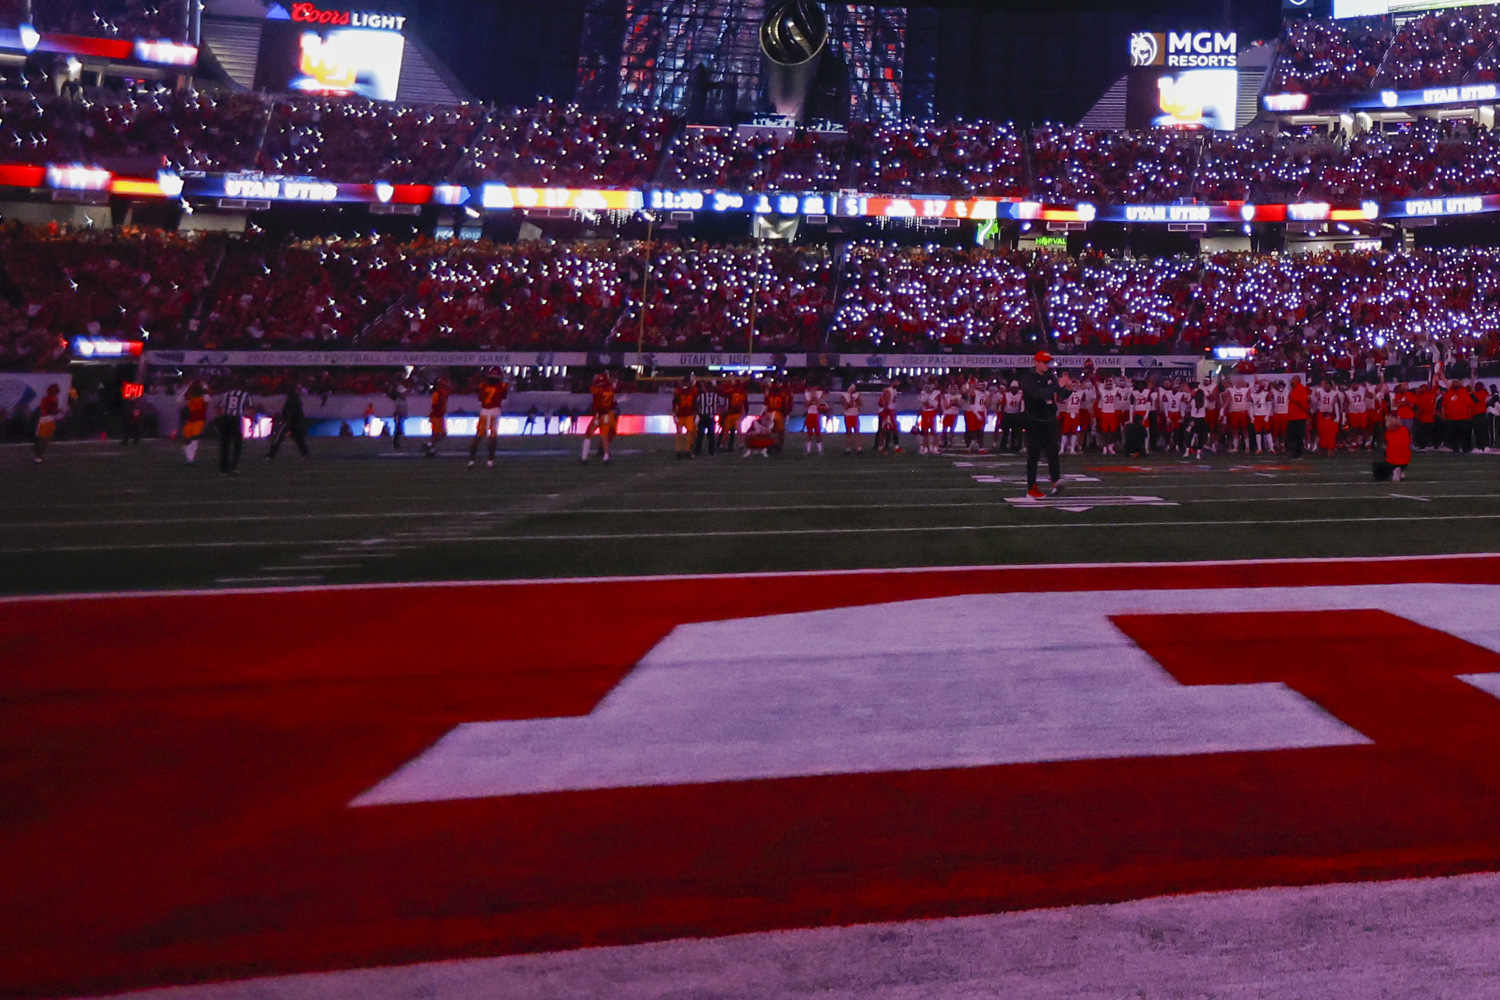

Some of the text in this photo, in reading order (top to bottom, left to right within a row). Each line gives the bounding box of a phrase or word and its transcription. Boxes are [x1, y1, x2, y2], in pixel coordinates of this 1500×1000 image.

[291, 2, 407, 29] Coors LIGHT
[1168, 32, 1237, 54] MGM
[1168, 55, 1237, 67] RESORTS
[225, 180, 280, 197] UTAH
[1405, 199, 1443, 215] UTAH
[680, 355, 707, 365] UTAH
[928, 355, 963, 366] PAC-12
[966, 356, 1014, 366] FOOTBALL
[484, 388, 496, 405] 7
